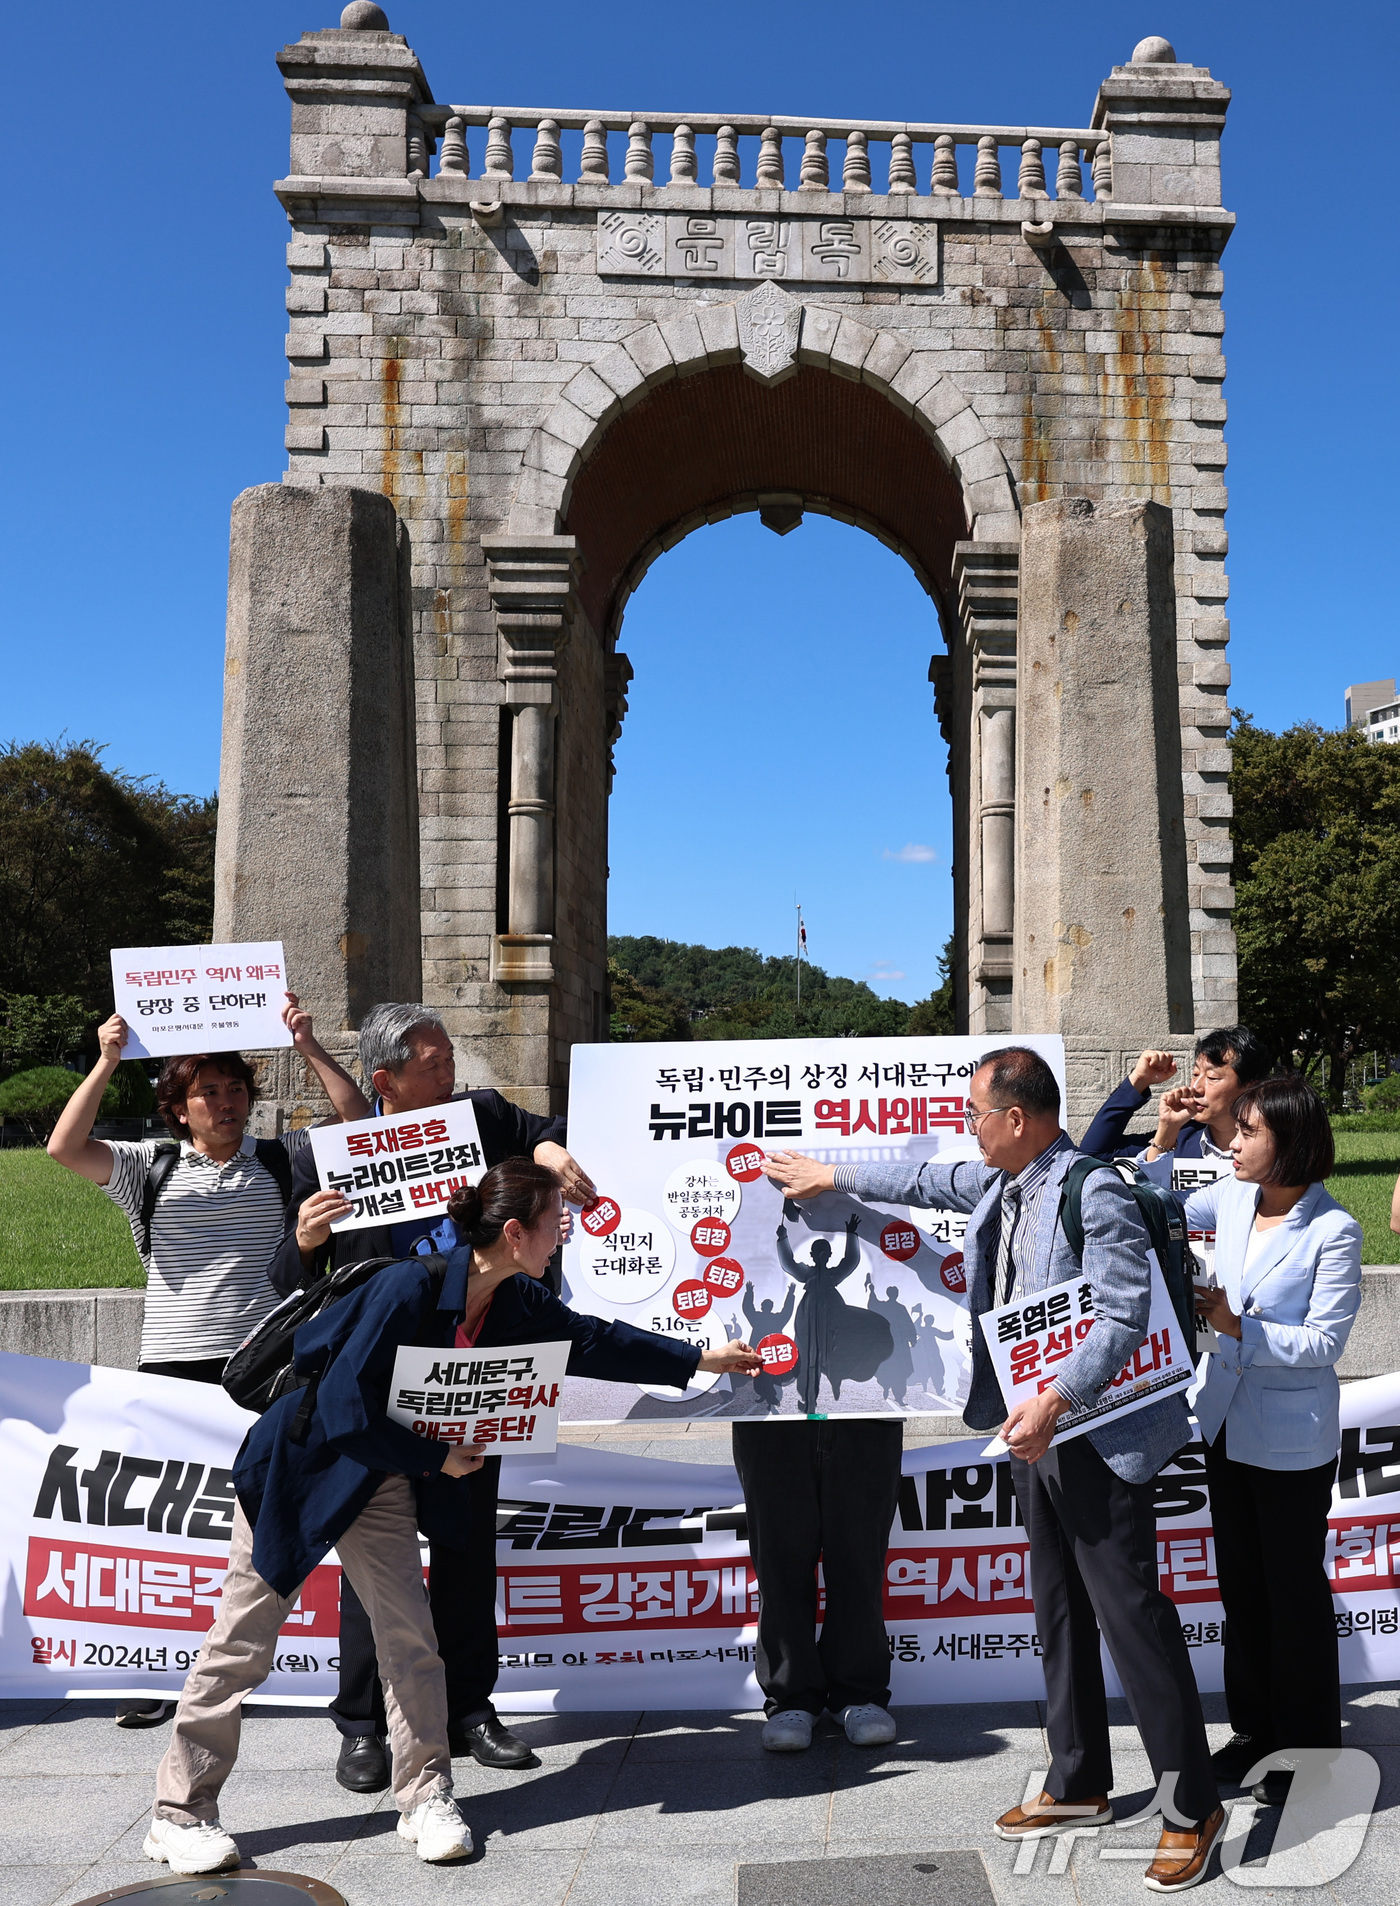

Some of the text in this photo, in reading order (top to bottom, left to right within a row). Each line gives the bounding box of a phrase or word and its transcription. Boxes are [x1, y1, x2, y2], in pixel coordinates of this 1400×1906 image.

[125, 963, 281, 988] 독립민주 역사 왜곡
[136, 993, 267, 1016] 당장 중 단하라!
[655, 1066, 791, 1093] 독립·민주의
[800, 1062, 848, 1089] 상징
[649, 1096, 975, 1141] 뉴라이트 역사왜곡
[346, 1118, 450, 1158] 독재옹호
[326, 1142, 481, 1194] 뉴라이트강좌
[729, 1150, 762, 1175] 퇴장
[684, 1175, 719, 1188] 강사는
[350, 1189, 406, 1219] 개설
[584, 1201, 617, 1233] 퇴장
[602, 1232, 653, 1252] 식민지
[694, 1227, 727, 1247] 퇴장
[884, 1231, 915, 1251] 퇴장
[591, 1256, 663, 1276] 근대화론
[706, 1265, 740, 1289] 퇴장
[676, 1288, 708, 1311] 퇴장
[997, 1291, 1072, 1344] 폭염은
[760, 1343, 793, 1365] 퇴장
[424, 1356, 538, 1387] 서대문구,
[396, 1383, 560, 1417] 독립민주역사
[472, 1414, 537, 1443] 중단!
[31, 1636, 77, 1667] 일시
[83, 1642, 168, 1672] 2024년
